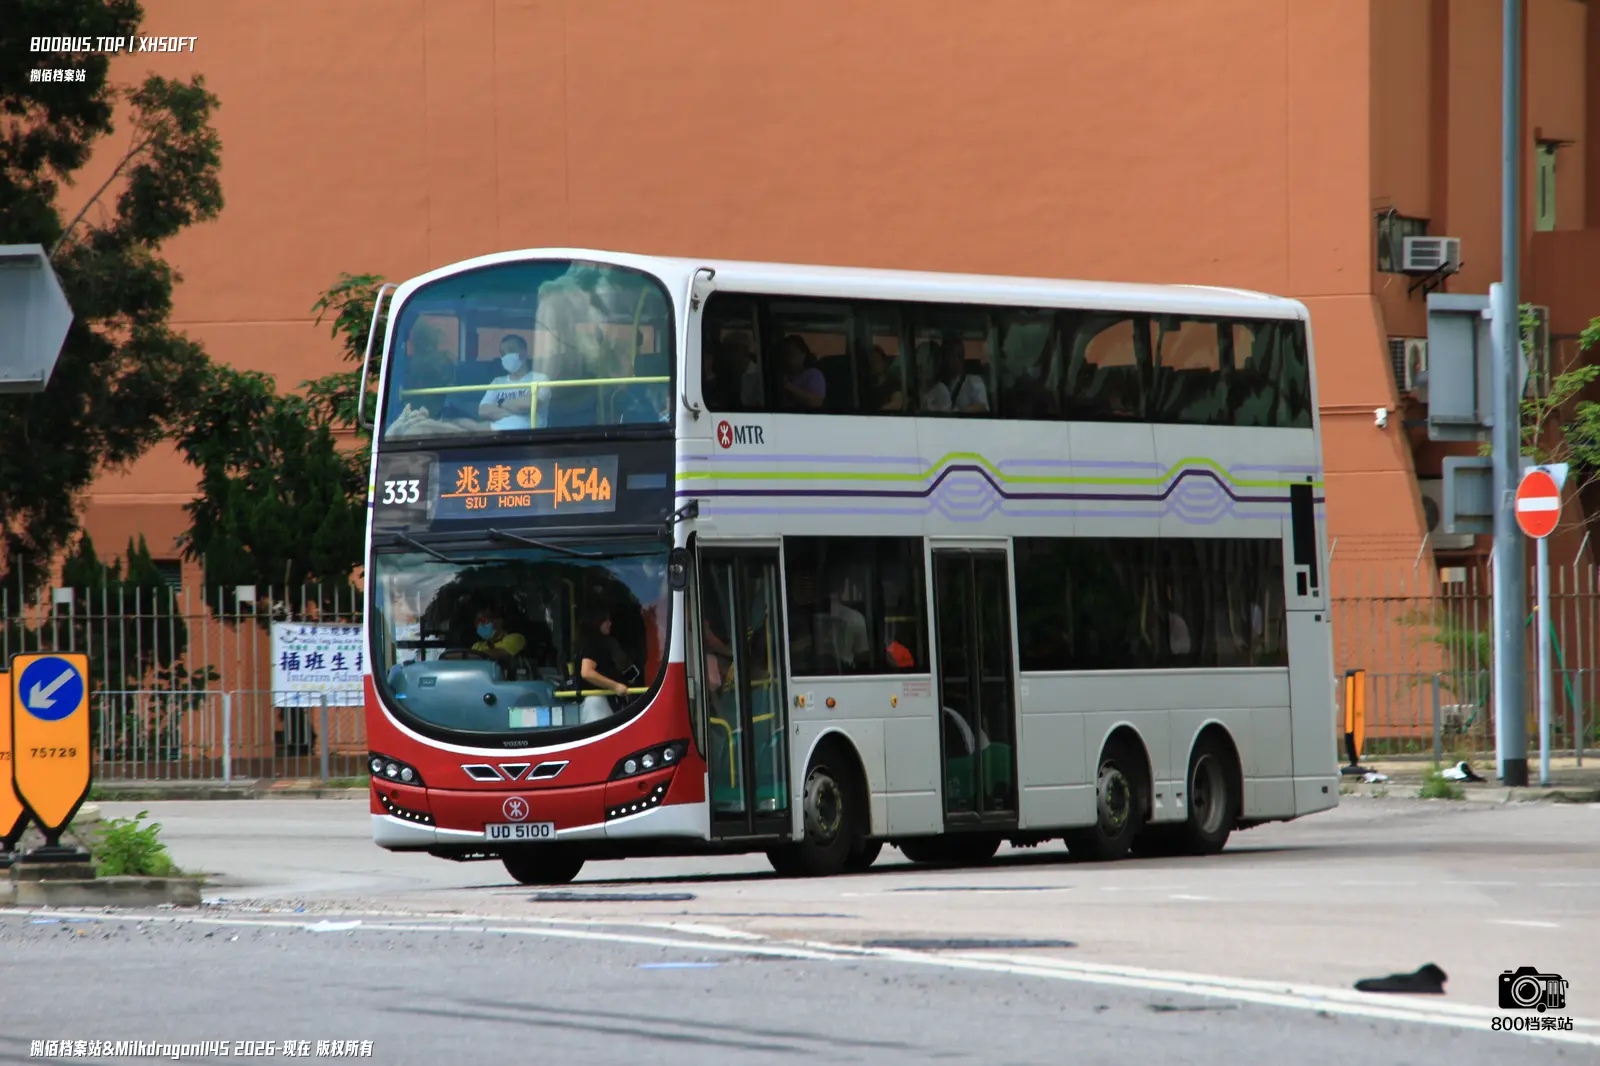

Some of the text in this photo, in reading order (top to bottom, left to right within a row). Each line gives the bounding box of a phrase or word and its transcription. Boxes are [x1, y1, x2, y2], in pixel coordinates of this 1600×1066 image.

[734, 425, 764, 444] MTR
[456, 465, 512, 494] 兆康
[557, 467, 611, 502] K54A
[382, 480, 420, 504] 333
[465, 495, 531, 509] SIU HONG
[491, 825, 549, 838] UD 5100
